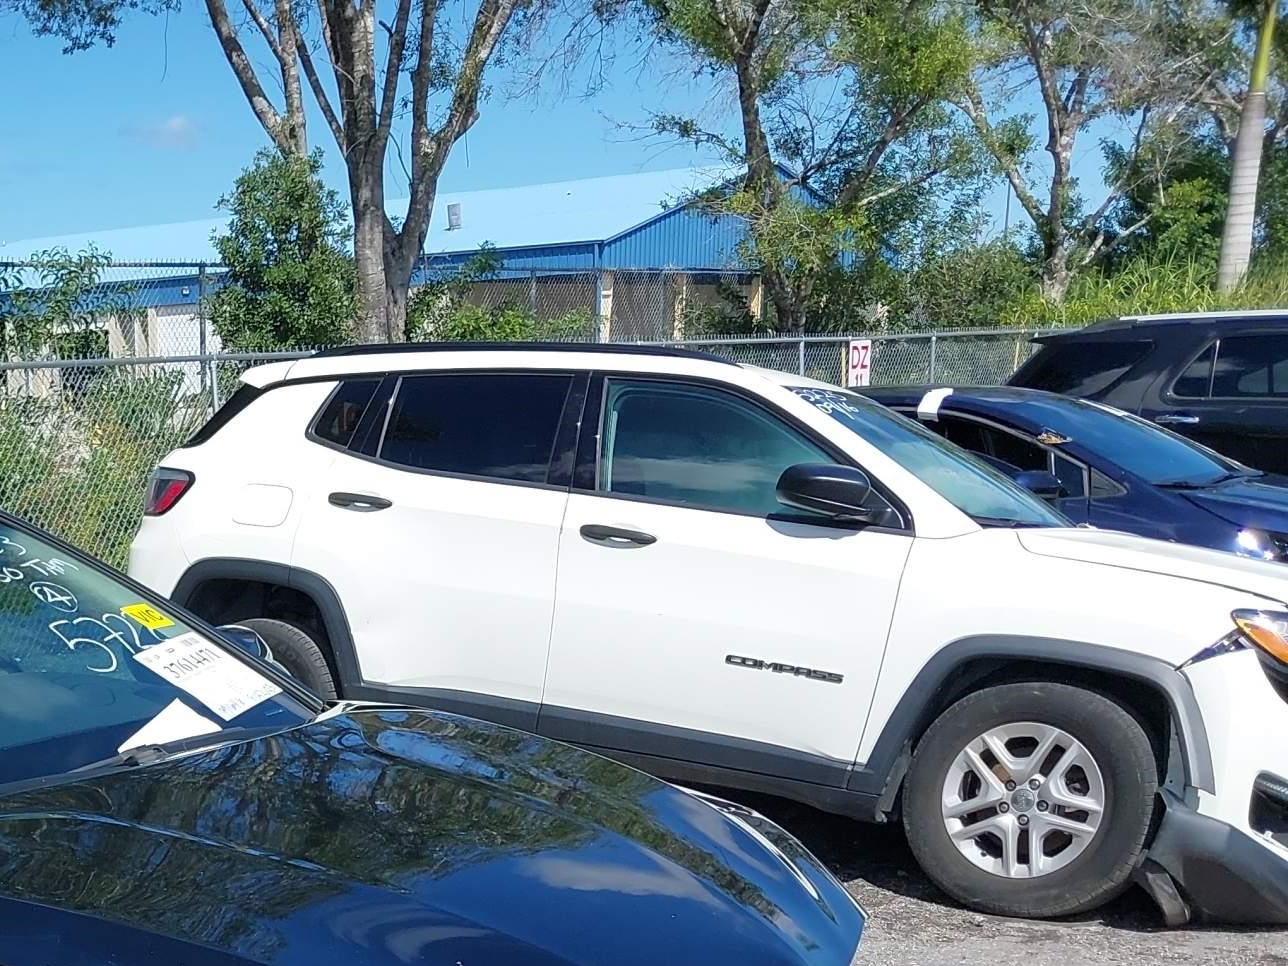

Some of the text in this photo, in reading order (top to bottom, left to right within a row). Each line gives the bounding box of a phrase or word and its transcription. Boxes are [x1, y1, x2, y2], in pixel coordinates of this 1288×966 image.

[851, 345, 869, 369] DZ
[163, 648, 223, 679] 37614471
[725, 653, 845, 684] COMPASS
